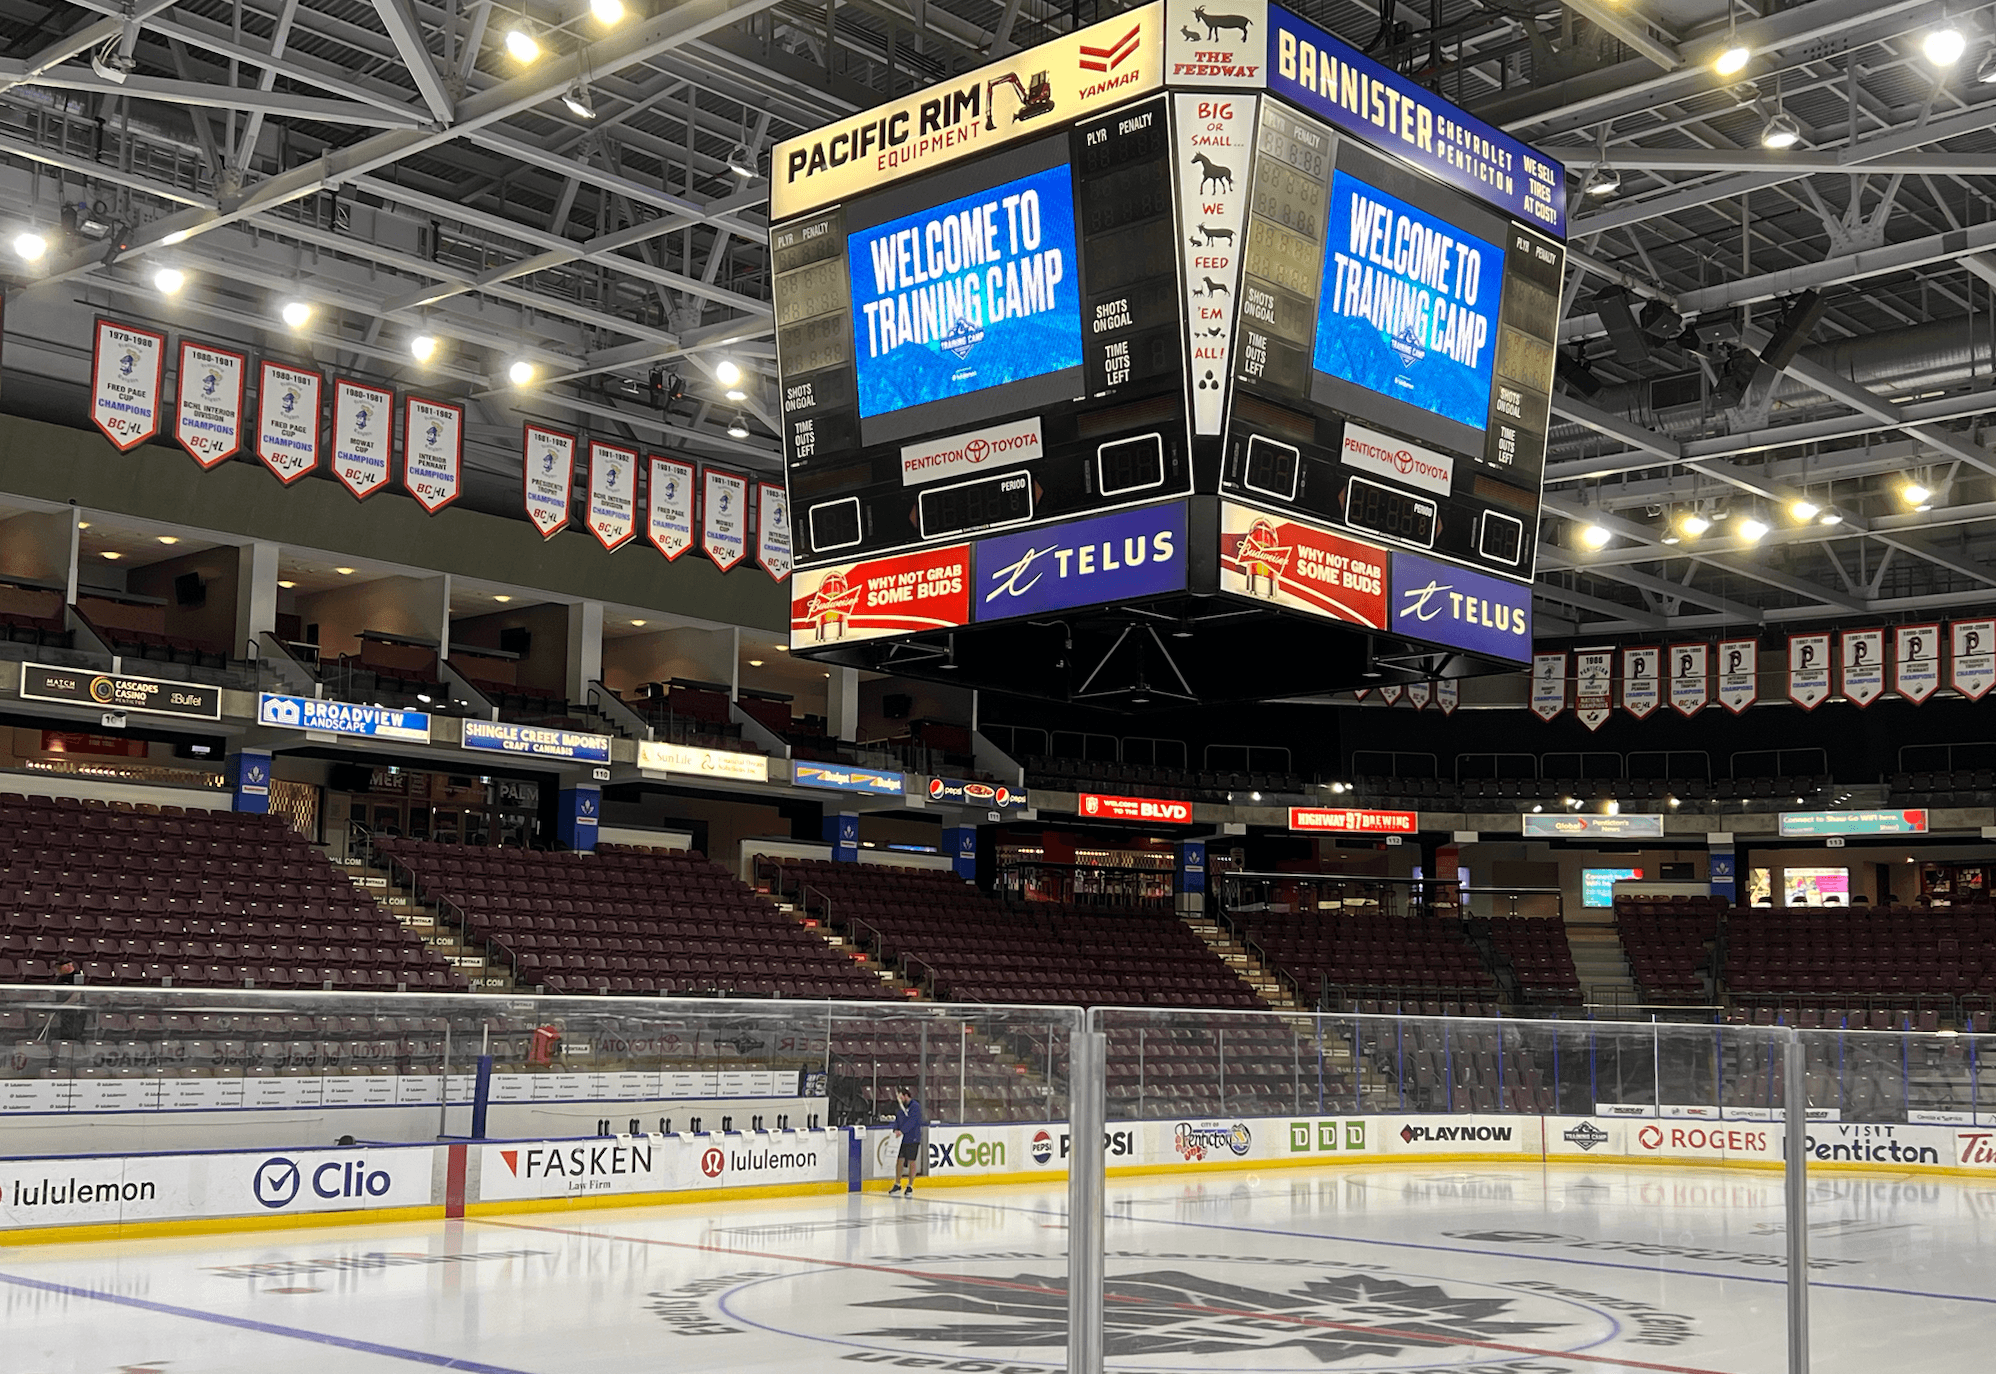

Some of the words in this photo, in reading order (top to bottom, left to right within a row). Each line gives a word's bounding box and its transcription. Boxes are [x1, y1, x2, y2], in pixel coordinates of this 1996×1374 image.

[1195, 51, 1233, 63] THE
[1173, 63, 1260, 78] FEEDWAY
[1079, 70, 1140, 100] YANMAR
[1278, 28, 1433, 154] BANNISTER
[1198, 103, 1234, 120] BIG
[788, 111, 909, 183] PACIFIC
[920, 83, 981, 136] RIM
[1087, 128, 1107, 147] PLYR
[1119, 112, 1153, 136] PENALTY
[1207, 123, 1224, 132] OR
[1191, 134, 1245, 148] SMALL...
[1293, 125, 1320, 149] PENALTY
[1437, 114, 1513, 172] CHEVROLET
[878, 121, 980, 172] EQUIPMENT
[1437, 141, 1513, 195] PENTICTON
[1523, 154, 1537, 176] WE
[1537, 159, 1556, 186] SELL
[1530, 176, 1552, 203] TIRES
[1202, 203, 1225, 216] WE
[1524, 195, 1534, 213] AT
[1534, 199, 1558, 226] COST!
[778, 232, 794, 248] PLYR
[802, 222, 829, 241] PENALTY
[870, 205, 1001, 295] WELCOME
[1003, 188, 1041, 251] TO
[1350, 193, 1455, 289] WELCOME
[1456, 239, 1482, 306] TO
[1535, 245, 1557, 266] PENALTY
[1195, 256, 1229, 270] FEED
[863, 266, 983, 357] TRAINING
[986, 248, 1063, 329] CAMP
[1248, 287, 1274, 309] SHOTS
[1096, 299, 1128, 318] SHOTS
[1198, 306, 1223, 320] 'EM
[1333, 252, 1428, 347] TRAINING
[1430, 293, 1487, 369] CAMP
[109, 330, 153, 348] 1979-1980
[1248, 331, 1267, 350] TIME
[1105, 341, 1128, 358] TIME
[1194, 346, 1225, 359] ALL!
[1245, 345, 1266, 364] OUTS
[192, 351, 233, 367] 1980-1981
[1105, 354, 1130, 373] OUTS
[1245, 359, 1264, 378] LEFT
[1107, 369, 1130, 386] LEFT
[107, 383, 126, 393] FRED
[787, 382, 812, 400] SHOTS
[1500, 386, 1520, 405] SHOTS
[119, 393, 134, 402] CUP
[98, 398, 152, 418] CHAMPIONS
[193, 411, 224, 422] DIVISION
[203, 404, 235, 418] INTERIOR
[182, 418, 234, 436] CHAMPIONS
[281, 429, 295, 437] CUP
[795, 419, 813, 434] TIME
[1500, 426, 1516, 441] TIME
[263, 435, 312, 452] CHAMPIONS
[795, 431, 815, 446] OUTS
[1498, 437, 1515, 454] OUTS
[355, 445, 368, 454] CUP
[797, 443, 815, 458] LEFT
[904, 449, 964, 473] PENTICTON
[991, 433, 1038, 454] TOYOTA
[1498, 449, 1513, 466] LEFT
[337, 451, 385, 468] CHAMPIONS
[1345, 438, 1393, 463] PENTICTON
[1414, 462, 1448, 482] TOYOTA
[409, 466, 454, 483] CHAMPIONS
[1001, 478, 1026, 493] PERIOD
[528, 492, 565, 508] CHAMPIONS
[1413, 503, 1433, 518] PERIOD
[1055, 531, 1174, 579] TELUS
[1237, 541, 1289, 566] Budweiser
[1297, 544, 1324, 563] WHY
[1326, 552, 1349, 570] NOT
[1350, 560, 1381, 579] GRAB
[867, 576, 897, 590] WHY
[898, 570, 924, 585] NOT
[926, 564, 962, 580] GRAB
[1297, 560, 1340, 585] SOME
[1342, 572, 1381, 596] BUDS
[867, 585, 913, 607] SOME
[917, 578, 962, 599] BUDS
[807, 597, 859, 613] Budweiser
[1450, 591, 1525, 635] TELUS
[46, 678, 76, 687] MATCH
[115, 681, 159, 694] CASCADES
[115, 690, 147, 701] CASINO
[176, 693, 202, 706] Buffet
[305, 702, 404, 727] BROADVIEW
[304, 716, 366, 733] LANDSCAPE
[466, 723, 518, 740] SHINGLE
[520, 730, 559, 746] CREEK
[562, 733, 608, 750] IMPORTS
[503, 741, 529, 751] CRAFT
[533, 744, 574, 756] CANNABIS
[657, 752, 674, 763] Sun
[676, 754, 692, 765] Life
[595, 770, 608, 778] 110
[945, 786, 962, 797] pepsi
[1010, 795, 1026, 804] pepsi
[1103, 800, 1138, 808] WELCOME
[1141, 802, 1187, 819] BLVD
[1298, 813, 1345, 826] HIGHWAY
[1346, 812, 1362, 829] 97
[1362, 815, 1410, 829] BREWING
[1555, 822, 1580, 830] Global
[1413, 1126, 1512, 1142] PLAYNOW
[1590, 1132, 1608, 1141] CAMP
[1839, 1125, 1895, 1137] VISIT
[1033, 1143, 1051, 1152] PEPSI
[1671, 1128, 1767, 1152] ROGERS
[526, 1146, 652, 1178] FASKEN
[731, 1149, 817, 1171] lululemon
[312, 1160, 391, 1199] Clio
[568, 1180, 587, 1191] Law
[589, 1179, 611, 1190] Firm
[13, 1178, 155, 1206] lululemon
[870, 1252, 1044, 1262] South
